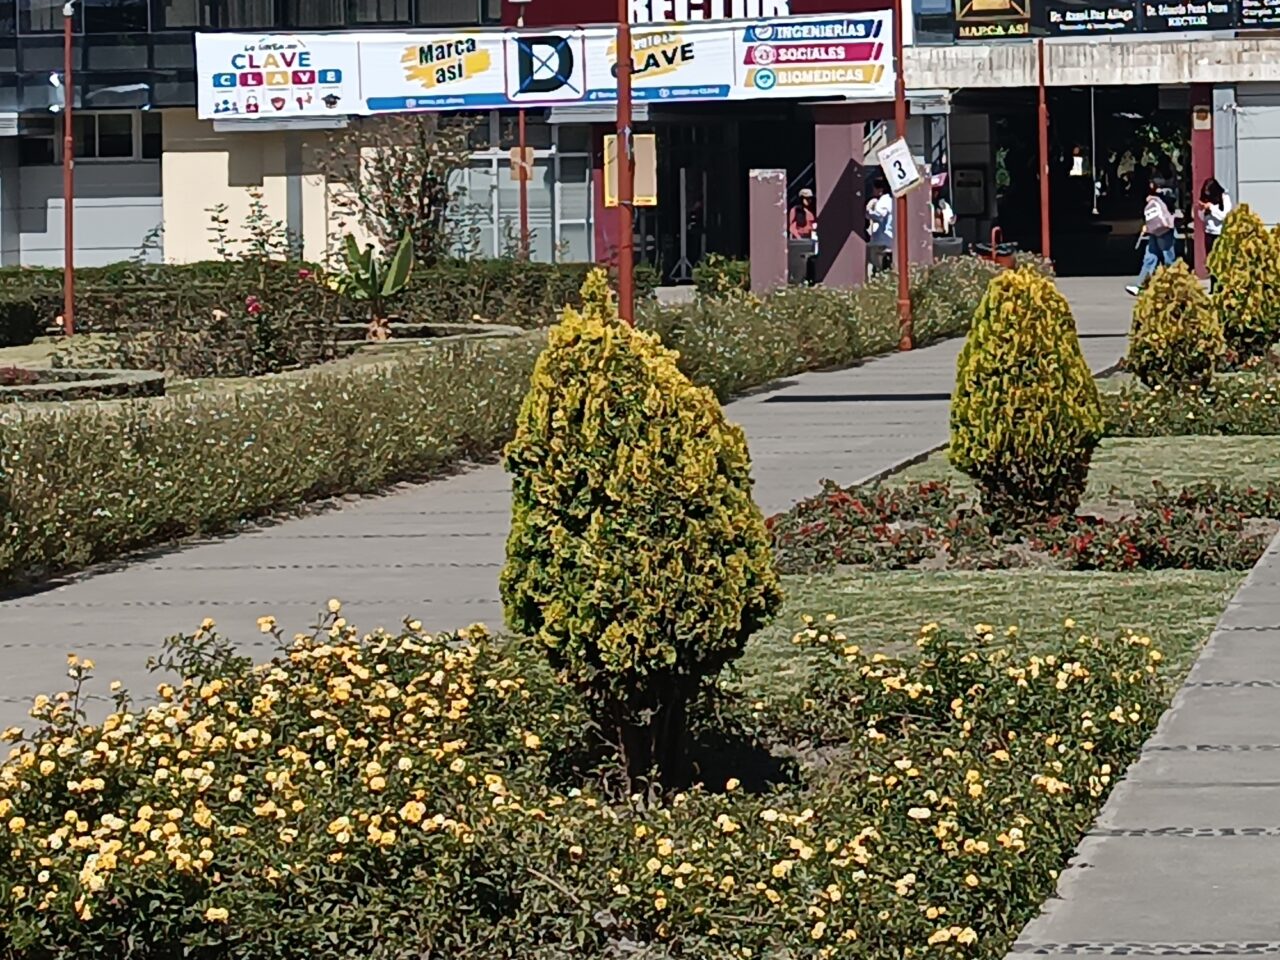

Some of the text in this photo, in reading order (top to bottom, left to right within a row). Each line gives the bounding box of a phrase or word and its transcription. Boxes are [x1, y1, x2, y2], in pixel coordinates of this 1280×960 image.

[776, 20, 867, 40] INGENIERÍAS
[959, 25, 1005, 38] MARCA
[231, 51, 311, 70] CLAVE
[419, 38, 476, 66] Marca
[778, 46, 846, 61] SOCIALES
[518, 35, 574, 94] D
[893, 160, 906, 179] 3
